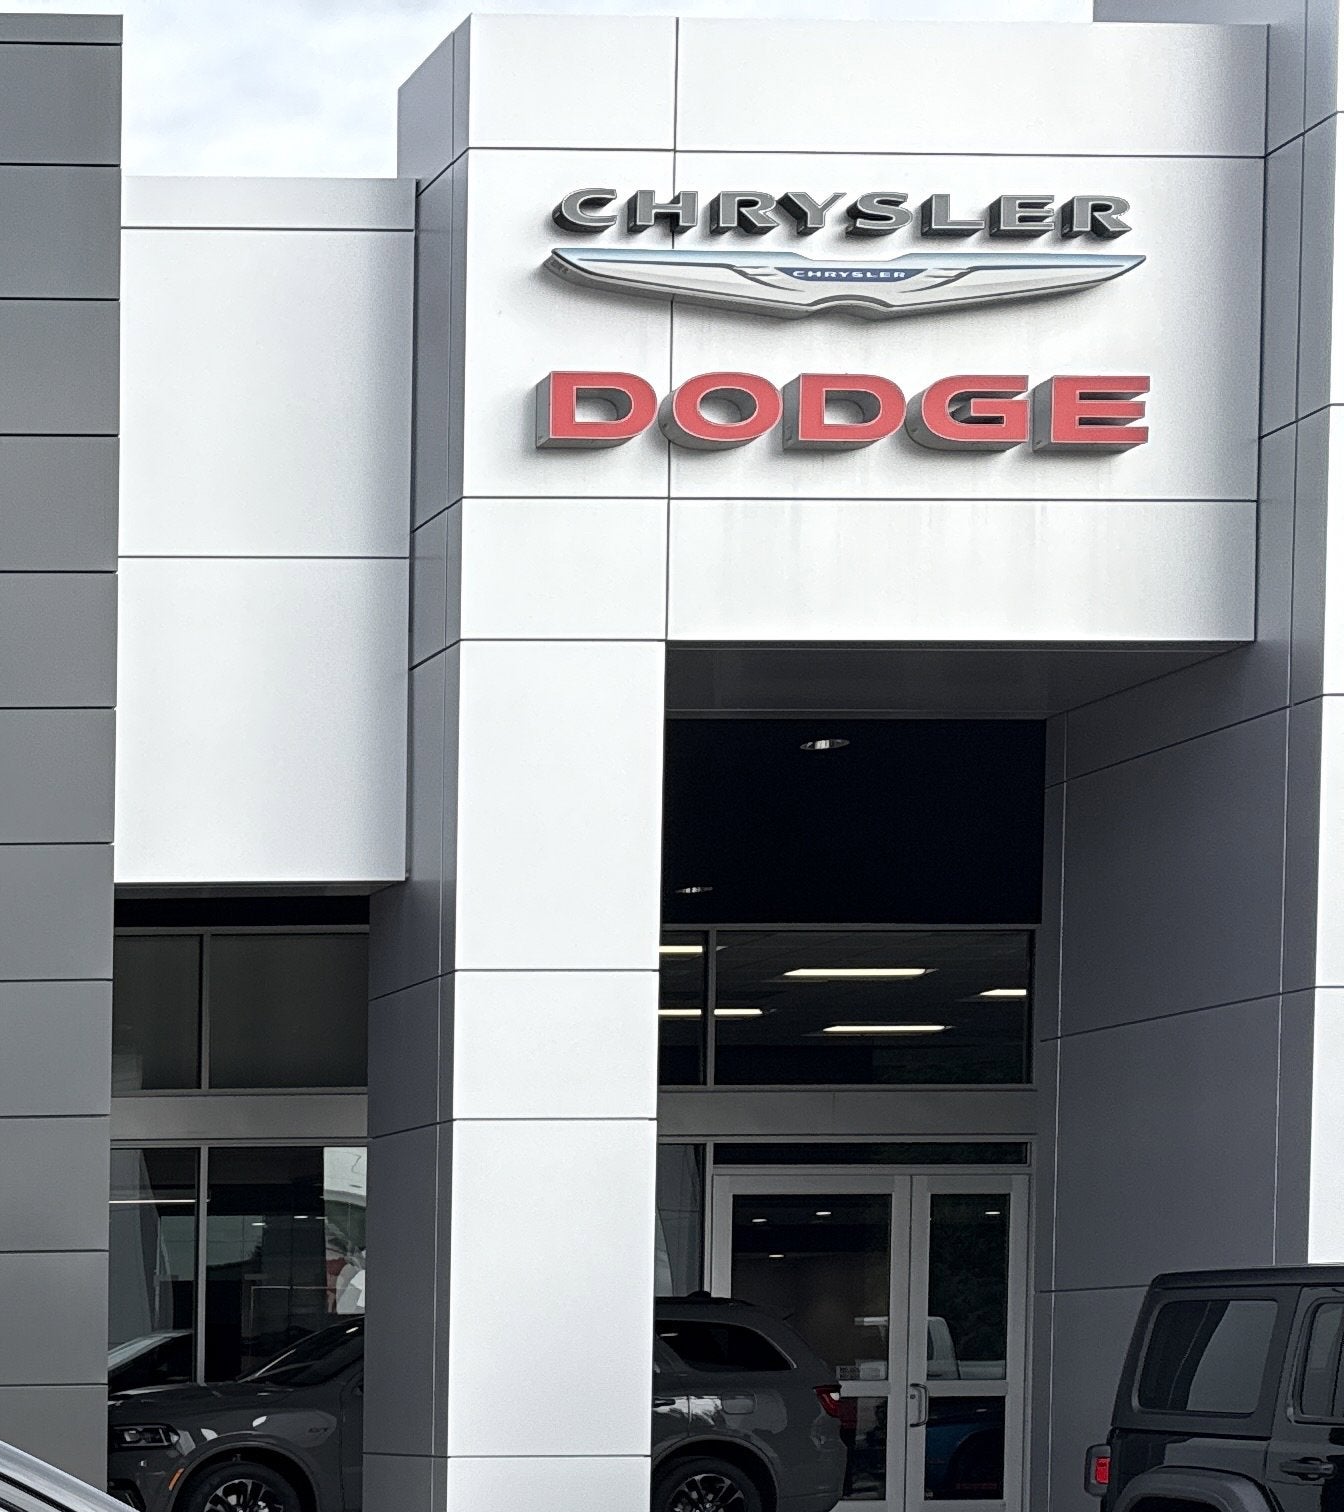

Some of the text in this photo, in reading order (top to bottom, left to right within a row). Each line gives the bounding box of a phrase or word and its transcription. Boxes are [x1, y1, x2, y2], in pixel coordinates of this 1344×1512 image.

[553, 187, 1132, 236] CHRYSLER
[792, 269, 906, 279] CHRYSLER
[538, 371, 1150, 450] DODGE
